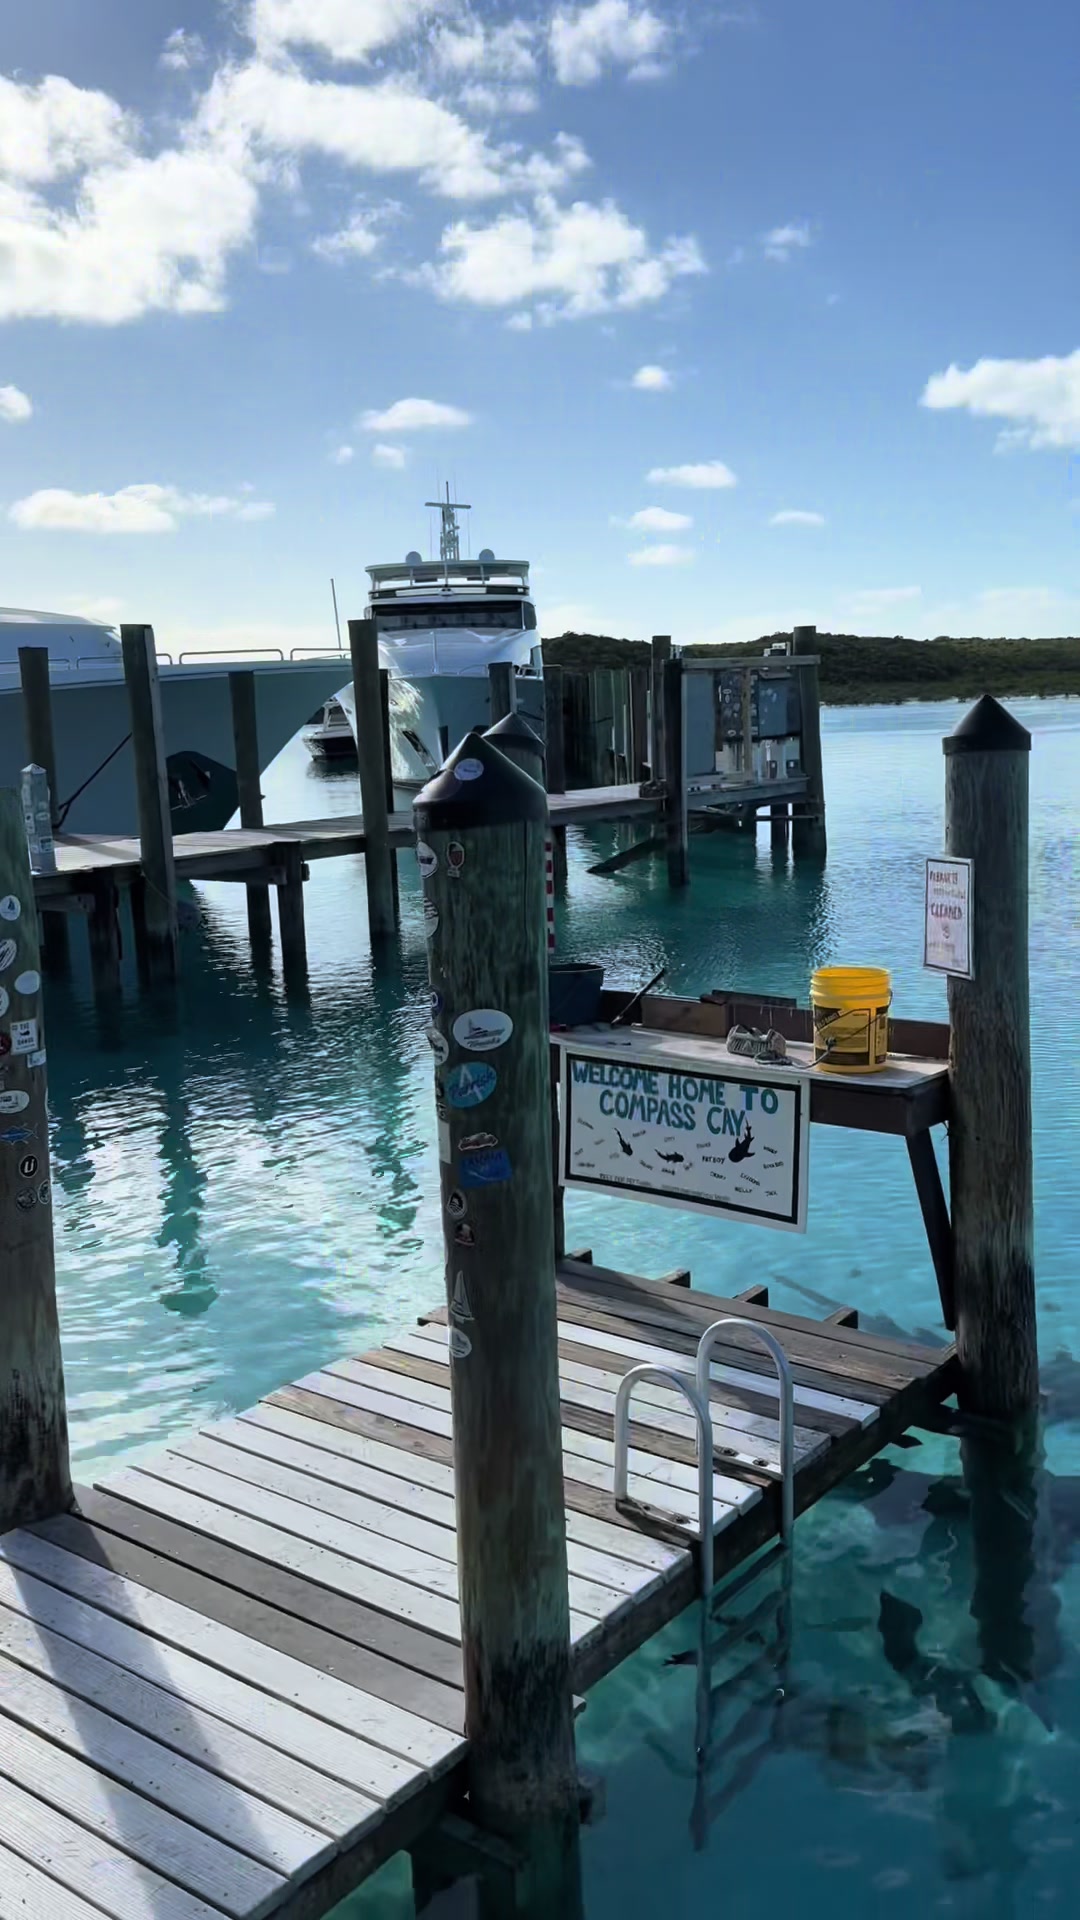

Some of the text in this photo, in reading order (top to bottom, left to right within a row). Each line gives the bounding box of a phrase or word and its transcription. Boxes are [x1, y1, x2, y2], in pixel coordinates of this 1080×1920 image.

[571, 1060, 779, 1115] WELCOME HOME TO
[599, 1089, 746, 1137] COMPASS CAY
